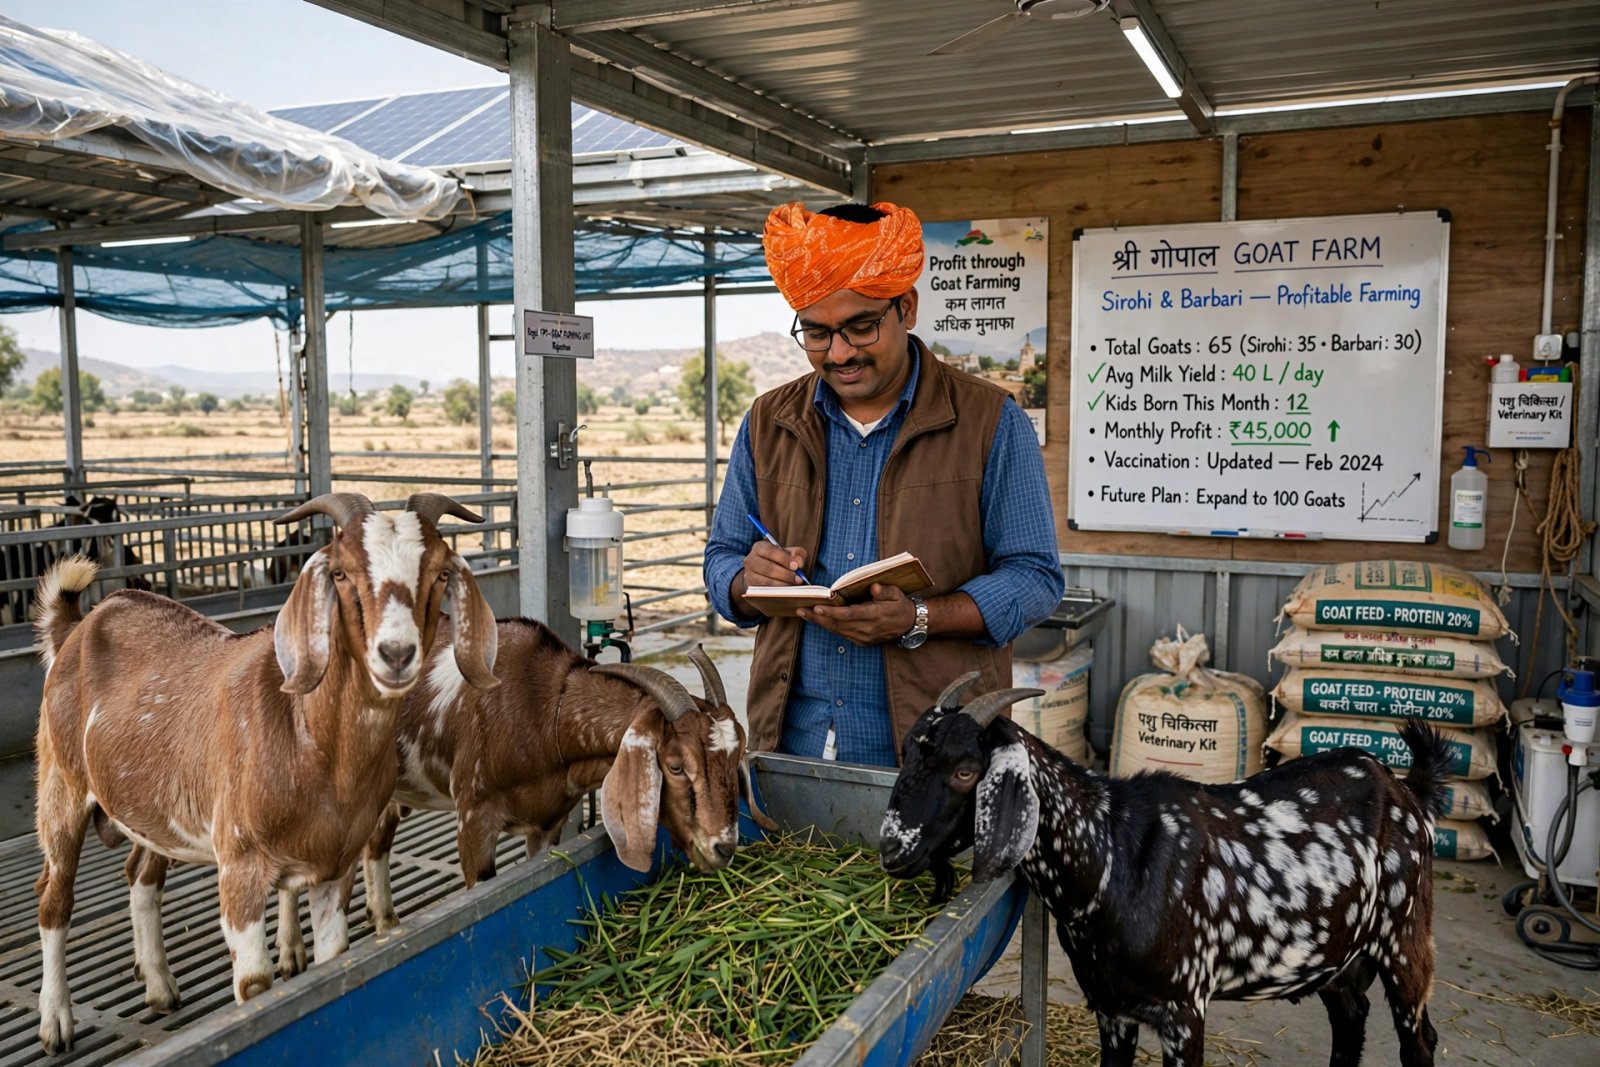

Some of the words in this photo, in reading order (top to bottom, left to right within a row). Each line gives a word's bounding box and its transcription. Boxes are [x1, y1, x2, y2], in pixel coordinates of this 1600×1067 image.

[929, 255, 967, 271] Profit
[971, 251, 1025, 272] through
[1111, 240, 1141, 271] श्री
[1150, 239, 1220, 268] गोपाल
[1234, 240, 1299, 265] GOAT
[1312, 236, 1381, 261] FARM
[930, 275, 962, 291] Goat
[965, 274, 1021, 292] Farming
[945, 297, 967, 312] कम
[971, 297, 1006, 311] लागत
[1101, 290, 1153, 312] Sirohi
[1160, 289, 1173, 309] &
[1181, 288, 1243, 309] Barbari
[1277, 284, 1353, 309] Profitable
[1360, 282, 1421, 309] Farming
[933, 315, 972, 332] अधिक
[975, 317, 1015, 336] मुनाफा
[1105, 338, 1141, 356] Total
[1208, 336, 1232, 354] 65
[1298, 335, 1317, 353] 35
[1394, 329, 1422, 354] 30)
[1105, 366, 1134, 390] Avg
[1140, 365, 1173, 383] Milk
[1232, 364, 1256, 382] 40
[1263, 364, 1273, 382] L
[1294, 362, 1325, 388] day
[1106, 393, 1137, 411] Kids
[1144, 393, 1178, 411] Born
[1183, 393, 1215, 411] This
[1287, 393, 1309, 411] 12
[1499, 397, 1516, 410] पशु
[1498, 409, 1546, 422] Veterinary
[1549, 409, 1562, 419] Kit
[1105, 421, 1164, 445] Monthly
[1229, 421, 1312, 442] ₹45,000
[1207, 452, 1273, 475] Updated
[1306, 454, 1332, 471] Feb
[1339, 454, 1384, 471] 2024
[1101, 486, 1146, 504] Future
[1196, 488, 1248, 509] Expand
[1253, 489, 1268, 506] to
[1273, 490, 1299, 507] 100
[1304, 490, 1346, 508] Goats
[1322, 606, 1353, 620] GOAT
[1355, 606, 1384, 620] FEED
[1394, 608, 1444, 626] PROTEIN
[1447, 612, 1473, 629] 20%
[1311, 683, 1342, 696] GOAT
[1344, 684, 1373, 698] FEED
[1383, 685, 1436, 703] PROTEIN
[1438, 691, 1466, 706] 20%
[1319, 696, 1350, 711] बकरी
[1353, 701, 1378, 713] चारा
[1390, 701, 1424, 716] प्रोटीन
[1427, 706, 1454, 719] 20%
[1138, 711, 1157, 732] पशु
[1161, 713, 1219, 732] चिकित्सा
[1138, 730, 1196, 752] Veterinary
[1200, 737, 1217, 751] Kit
[1309, 731, 1340, 743] GOAT
[1342, 733, 1372, 747] FEED
[1387, 751, 1414, 766] प्रोटी
